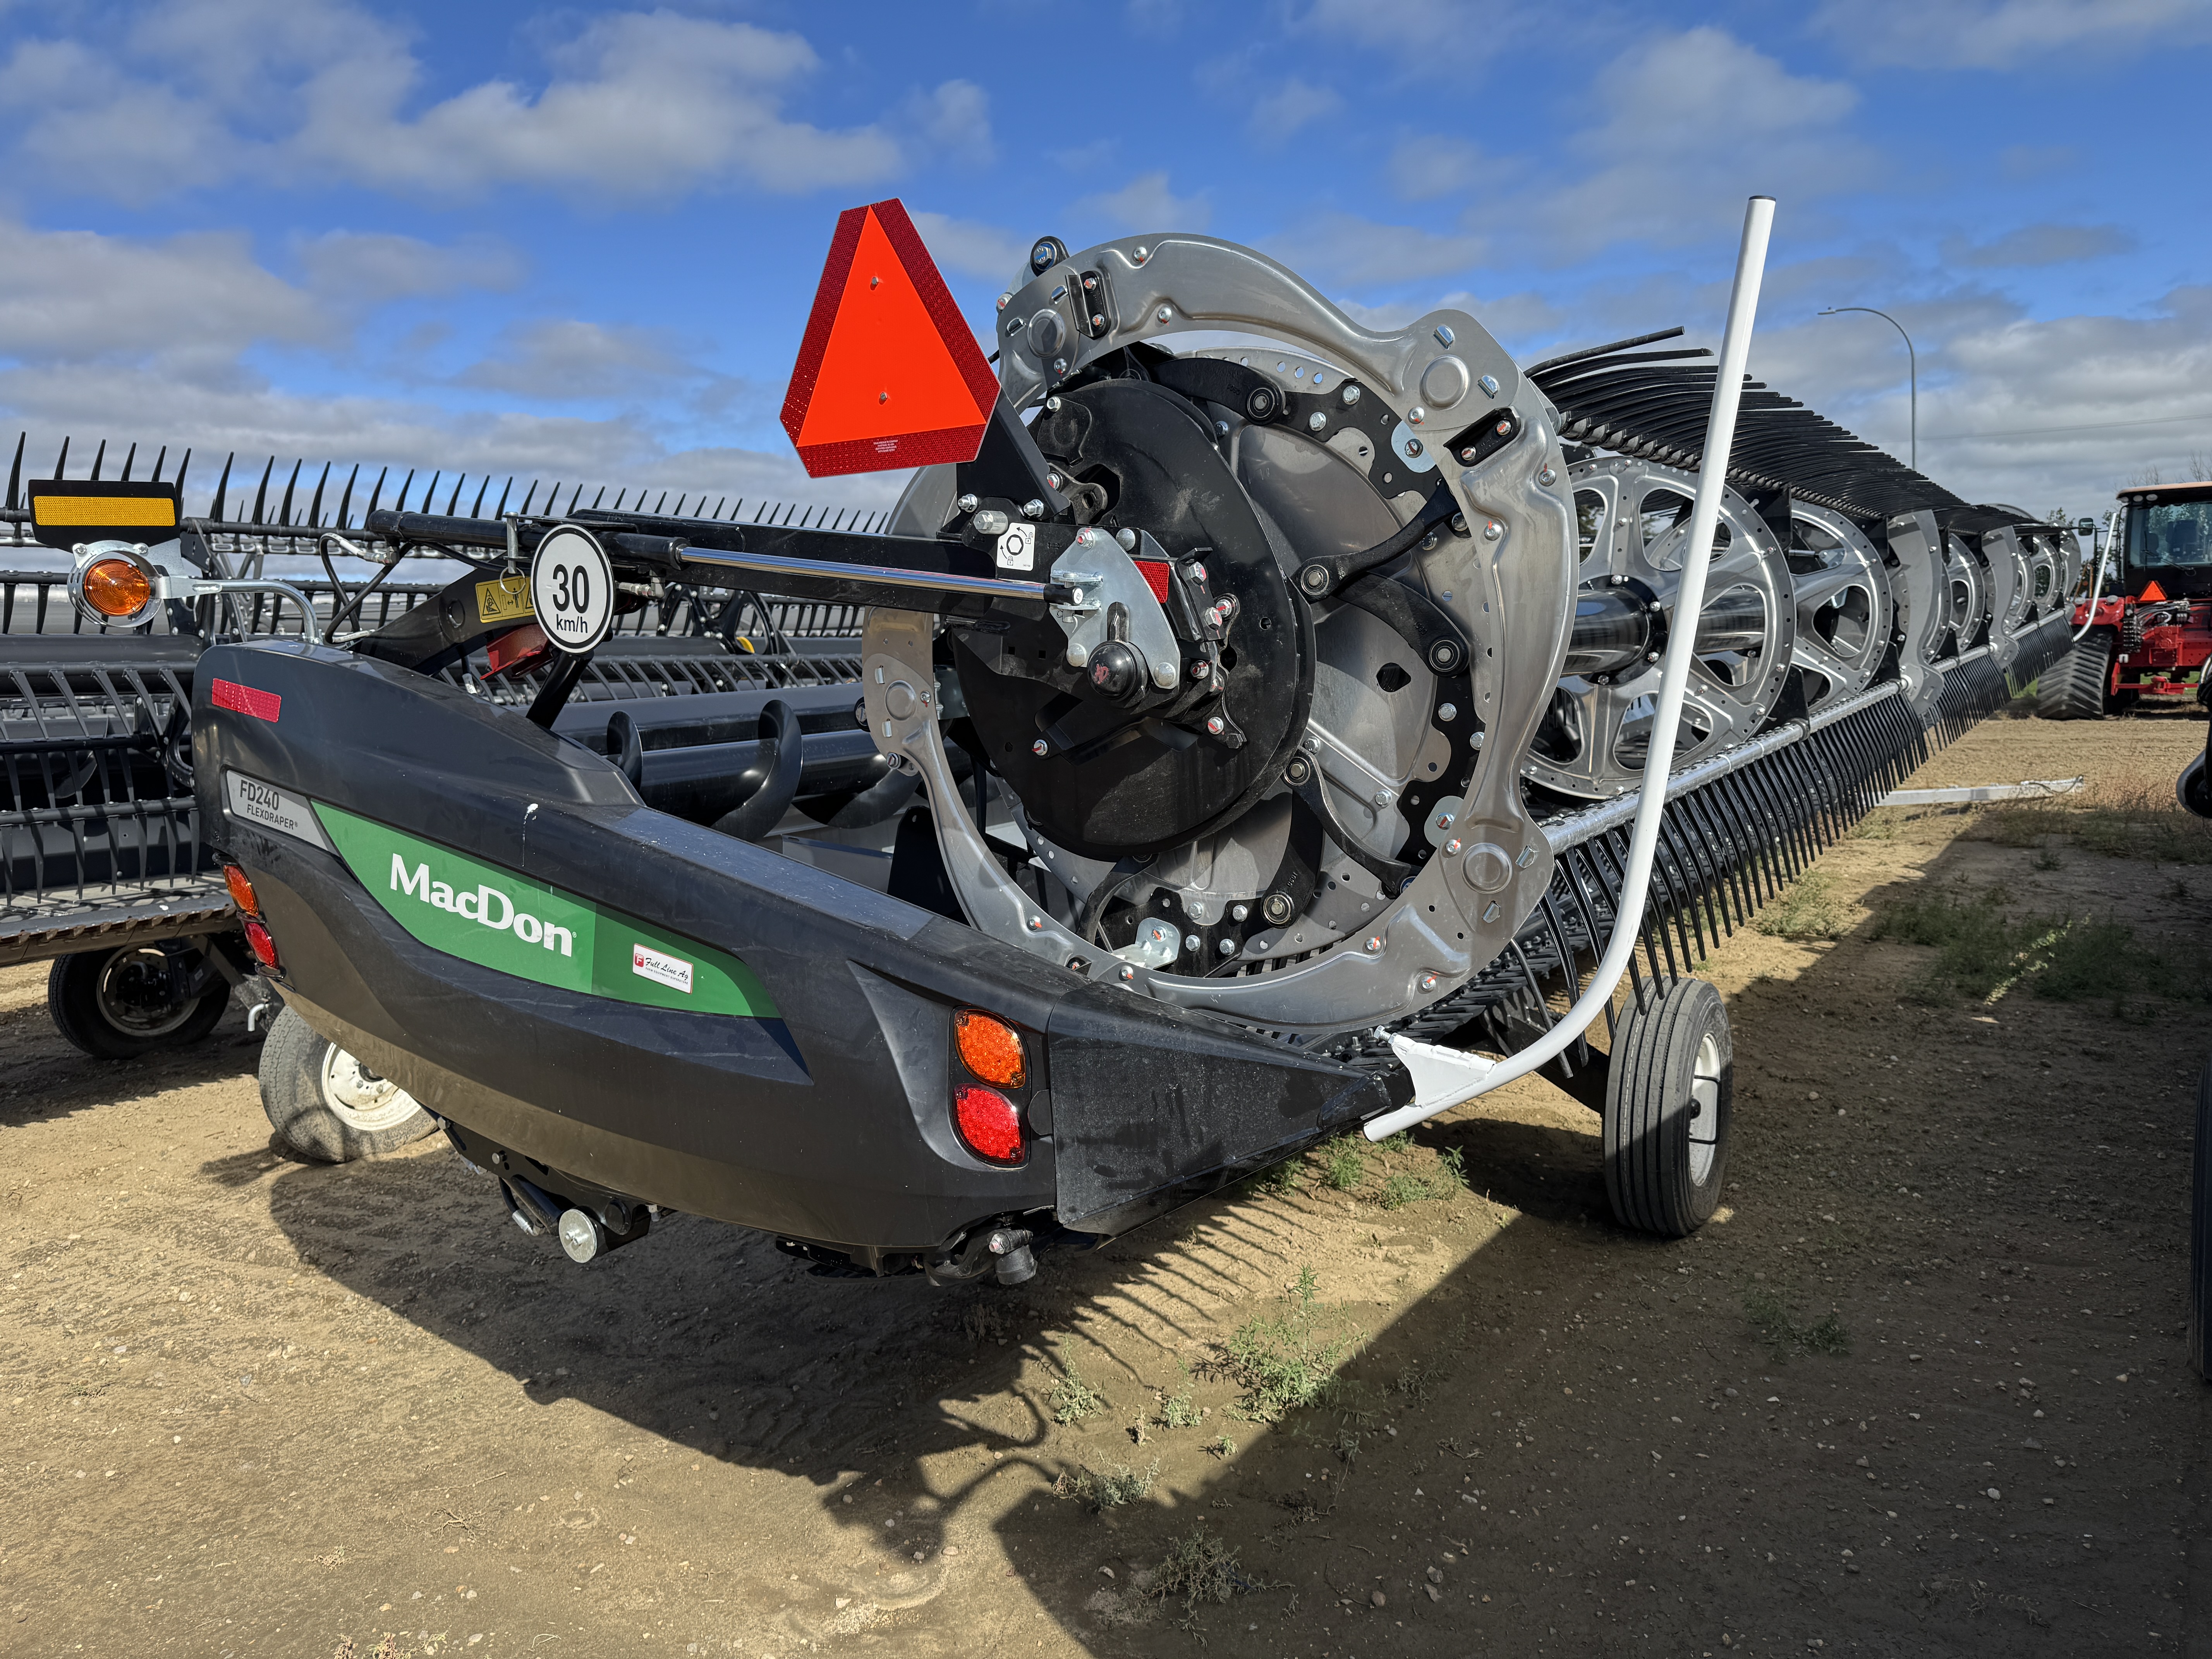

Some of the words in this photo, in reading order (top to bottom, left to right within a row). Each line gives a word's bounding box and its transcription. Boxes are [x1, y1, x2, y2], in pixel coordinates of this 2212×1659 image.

[553, 564, 589, 613] 30
[556, 614, 588, 633] km/h
[240, 779, 279, 811] FD240
[646, 957, 660, 969] Full
[661, 963, 677, 975] Line
[677, 970, 689, 981] Ag
